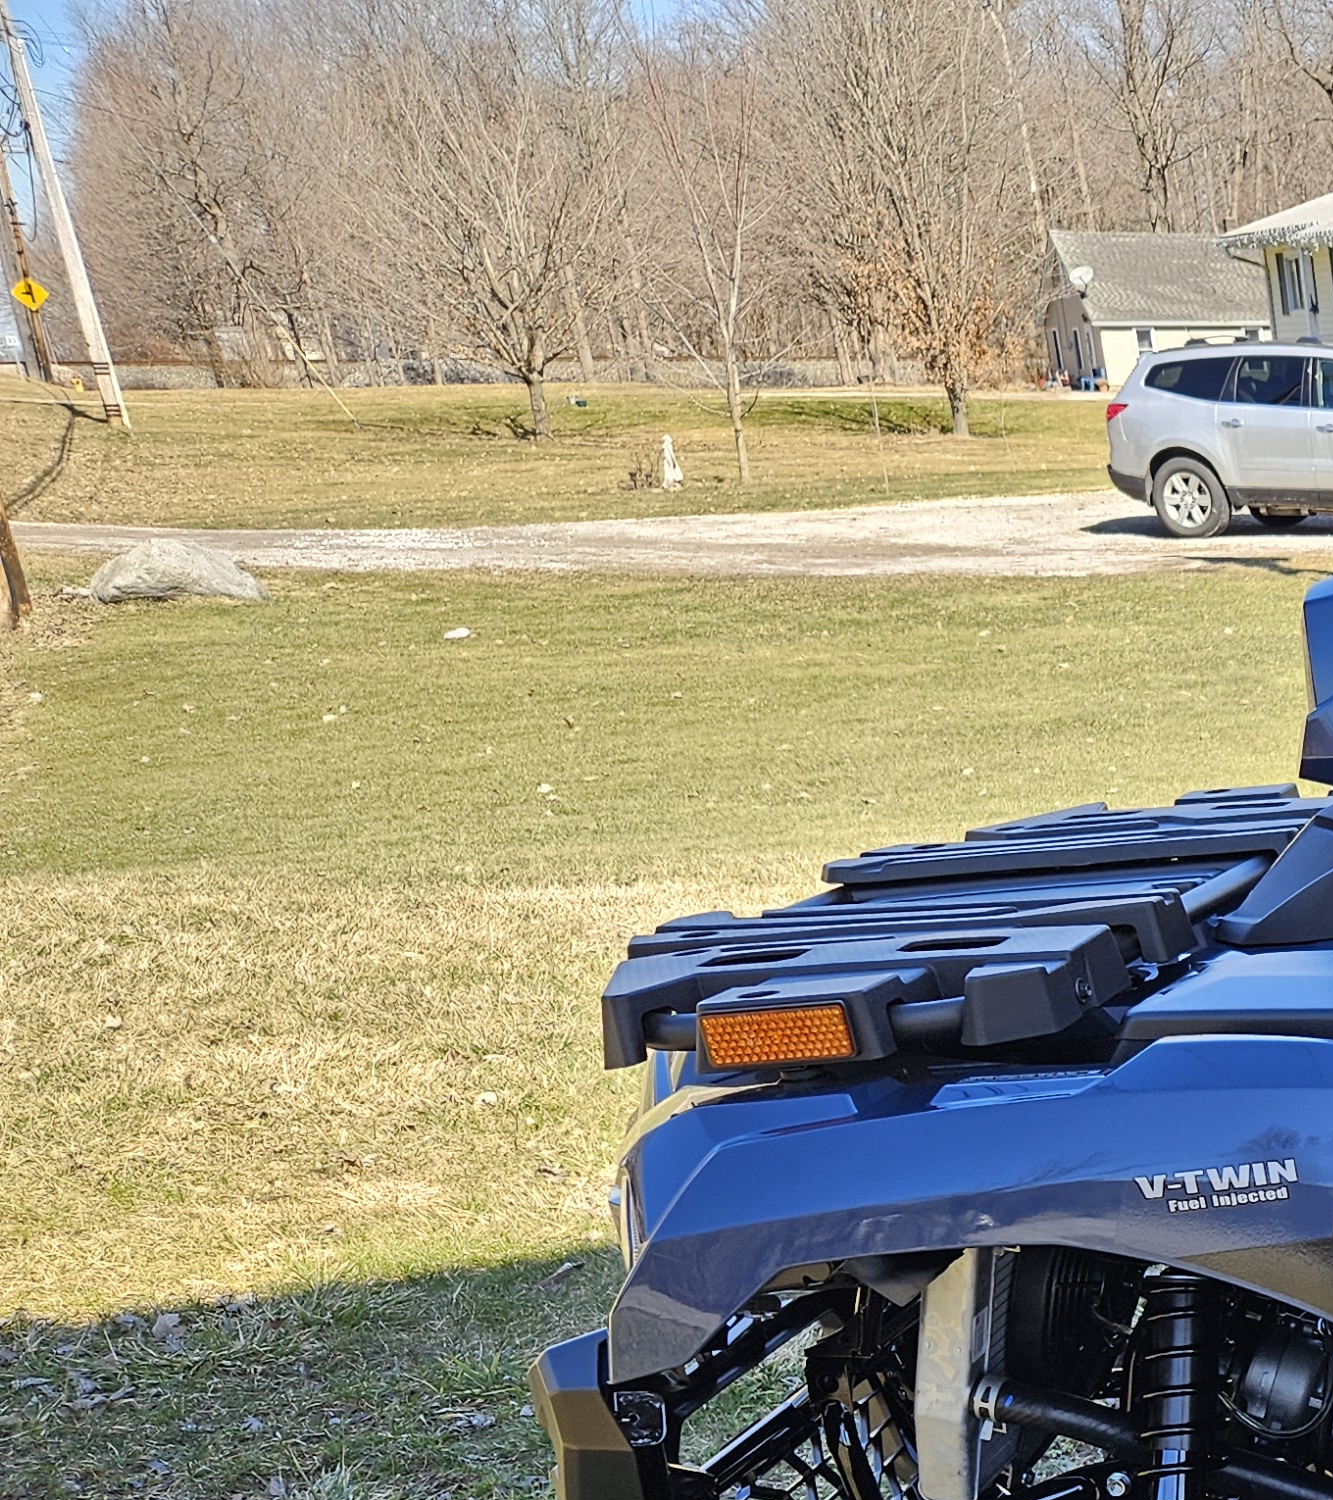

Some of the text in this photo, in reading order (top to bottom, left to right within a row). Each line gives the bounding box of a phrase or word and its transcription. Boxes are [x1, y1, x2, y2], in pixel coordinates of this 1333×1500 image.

[1134, 1158, 1298, 1200] V-TWIN
[1168, 1186, 1289, 1213] Fuel Injected
